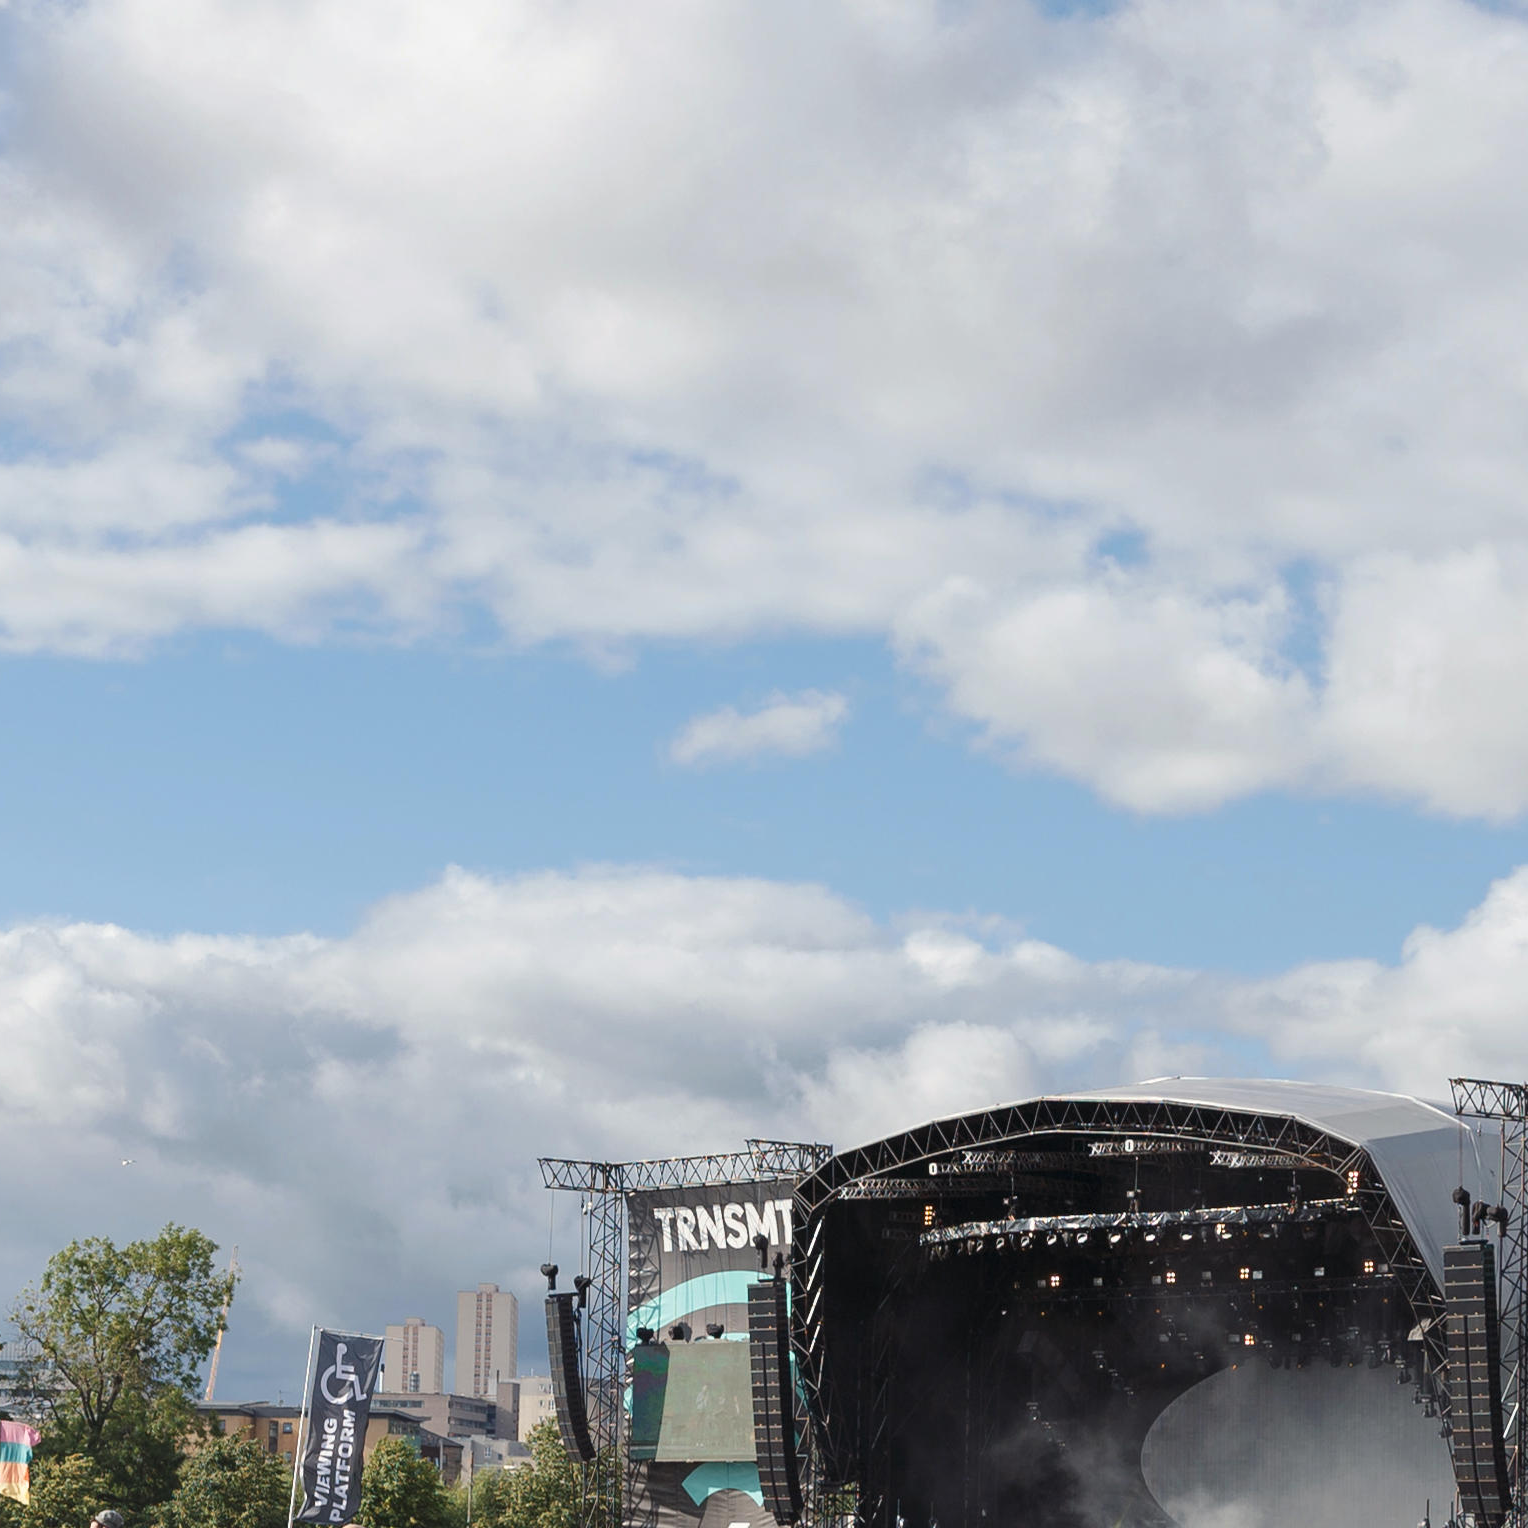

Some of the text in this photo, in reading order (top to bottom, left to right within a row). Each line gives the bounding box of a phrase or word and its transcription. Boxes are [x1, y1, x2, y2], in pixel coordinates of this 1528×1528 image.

[653, 1199, 793, 1252] TRNSMT
[313, 1417, 338, 1507] VIEWING
[329, 1409, 356, 1523] PLATFORM
